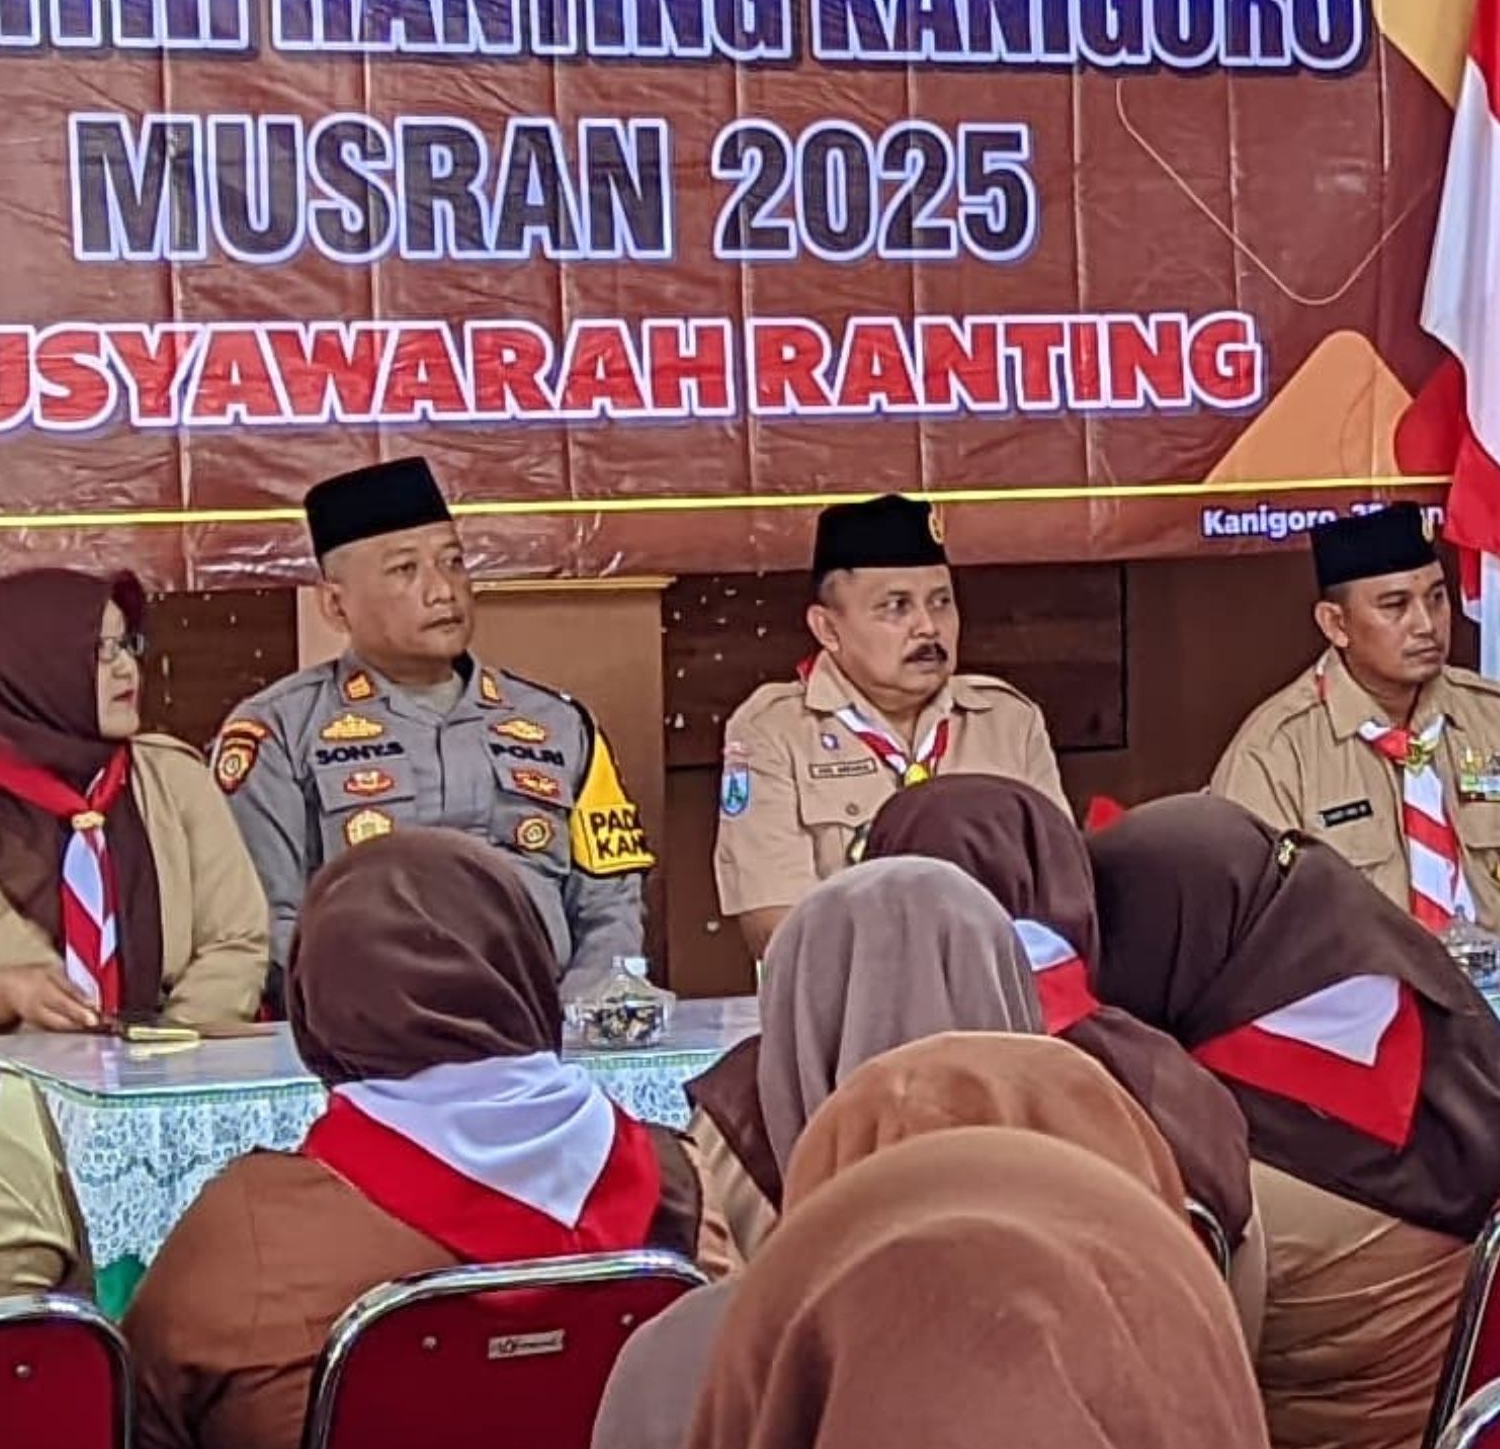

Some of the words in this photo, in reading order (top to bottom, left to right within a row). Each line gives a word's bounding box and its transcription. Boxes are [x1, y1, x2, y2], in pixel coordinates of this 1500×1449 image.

[68, 111, 671, 263] MUSRAN
[711, 118, 1036, 261] 2025
[749, 311, 1262, 413] RANTING
[488, 743, 565, 767] POLRI
